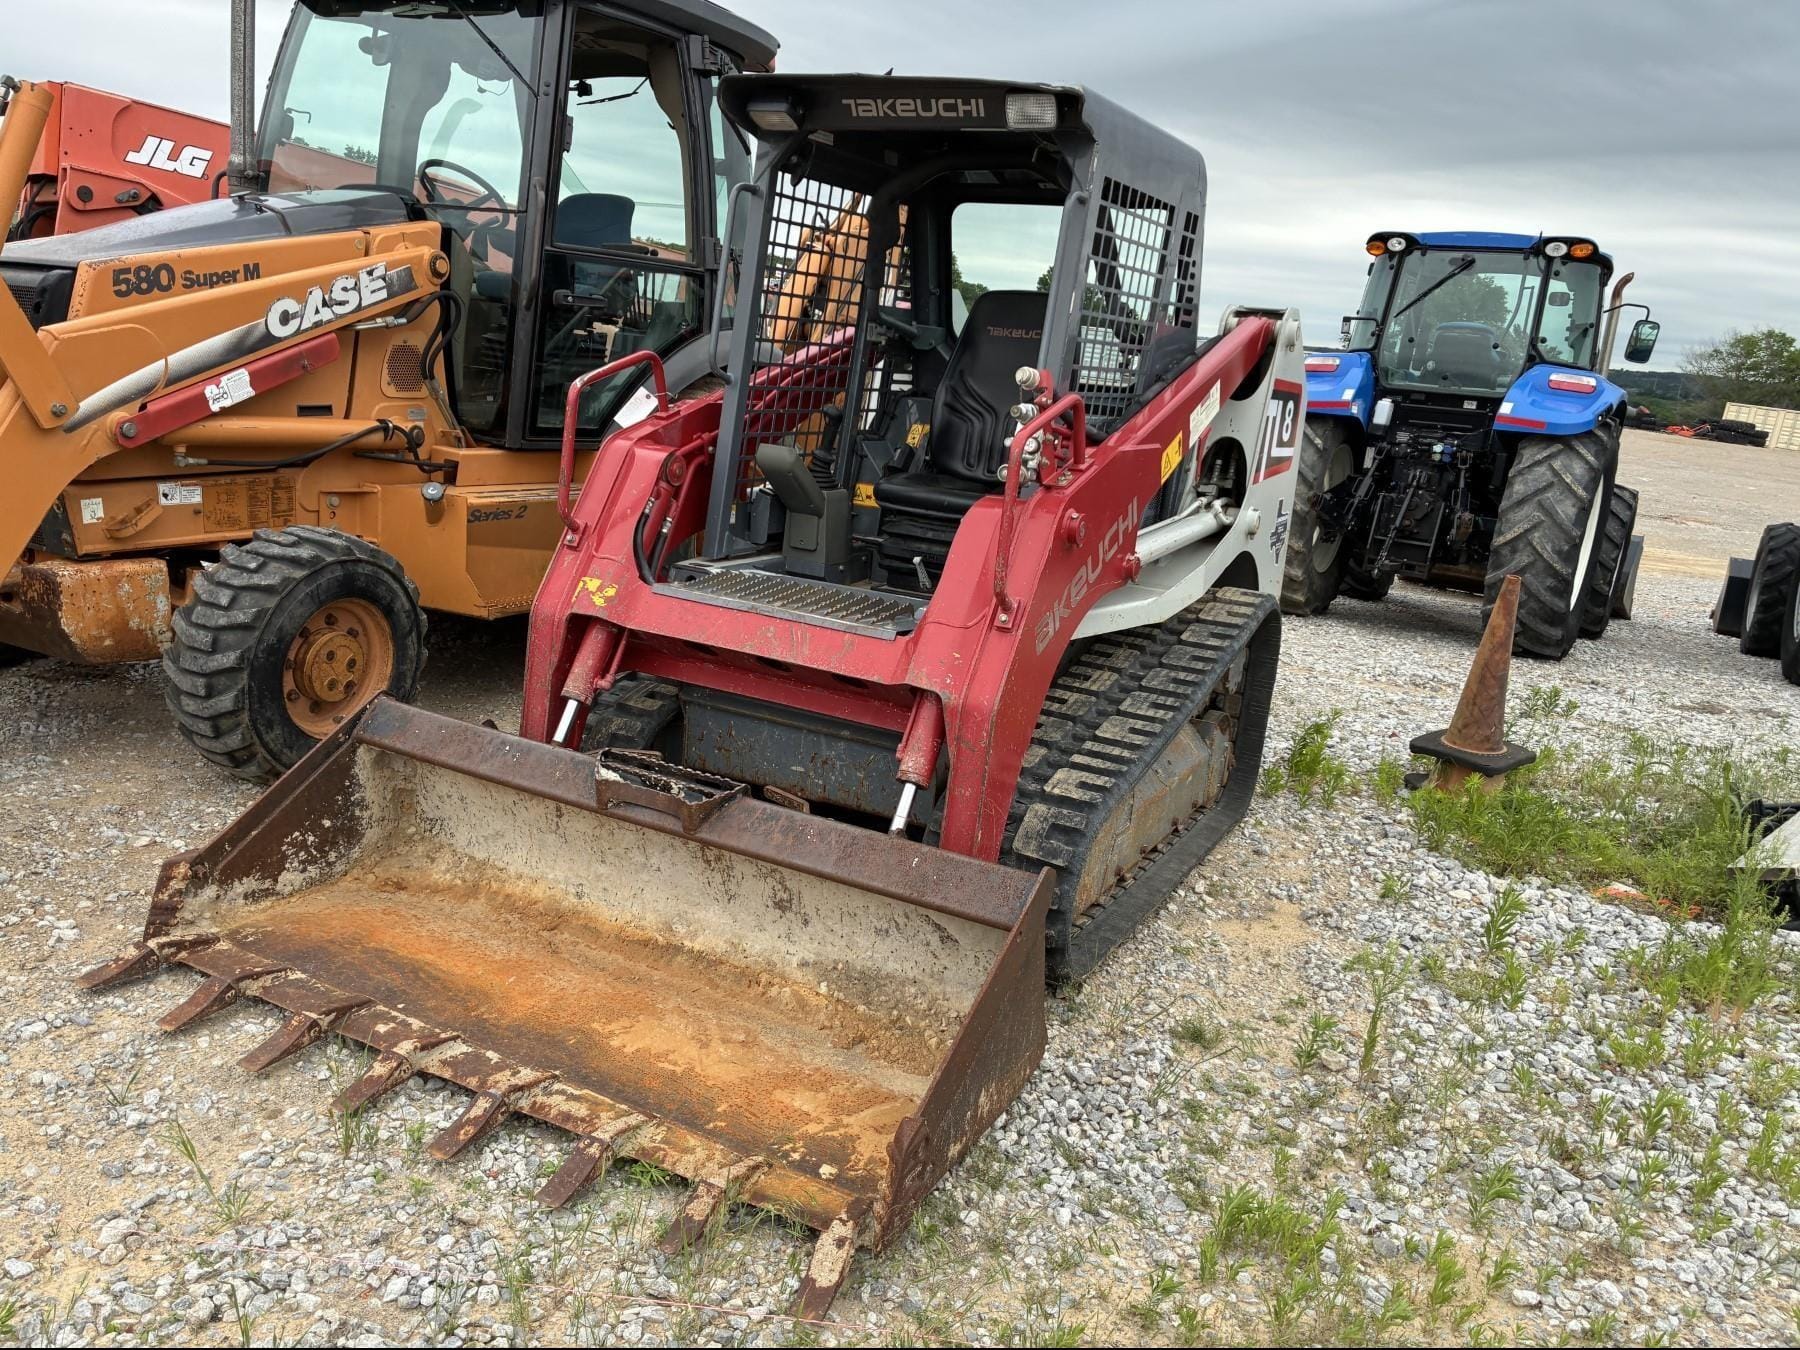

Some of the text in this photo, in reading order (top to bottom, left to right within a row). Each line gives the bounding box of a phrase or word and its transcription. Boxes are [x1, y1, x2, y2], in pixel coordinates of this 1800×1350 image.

[124, 135, 213, 179] JLG
[112, 262, 261, 298] 580 Super M
[265, 262, 387, 338] CASE
[986, 326, 1042, 339] TAKEUC
[467, 505, 528, 523] Series 2
